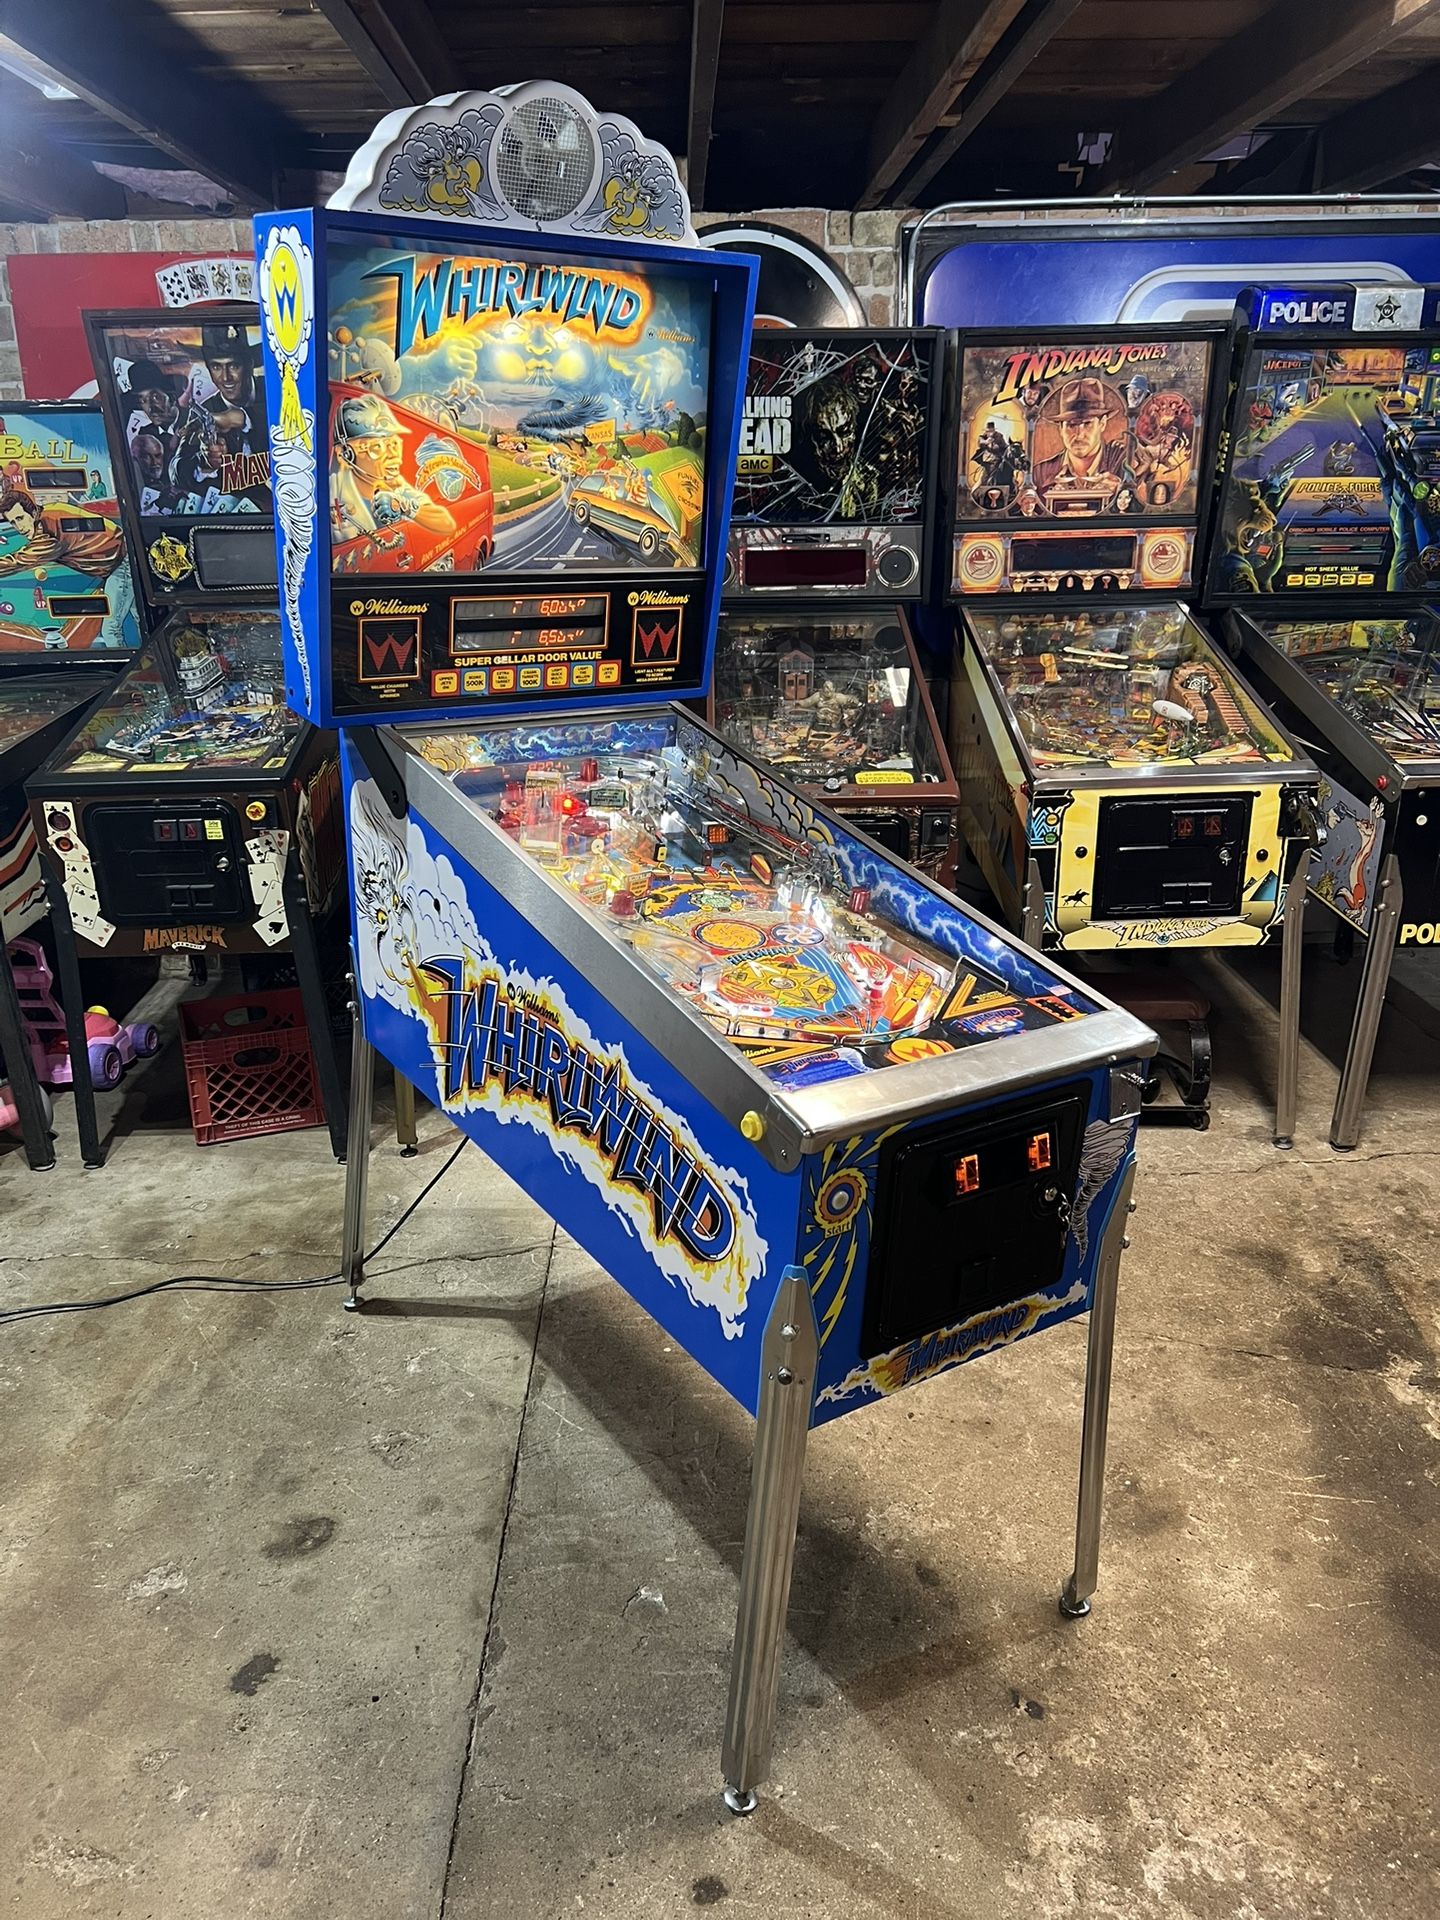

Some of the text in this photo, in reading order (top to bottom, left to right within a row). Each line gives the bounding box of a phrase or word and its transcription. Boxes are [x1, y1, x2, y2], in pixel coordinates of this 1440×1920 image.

[360, 254, 644, 361] WHIRLWIND
[1268, 300, 1347, 323] POLICE
[993, 345, 1168, 406] INDIANA JONES
[0, 434, 88, 463] BALL
[738, 418, 792, 454] EAD
[1297, 482, 1382, 493] POLICE FORCE
[365, 598, 429, 615] Williams
[640, 589, 690, 605] Williams
[454, 656, 492, 667] SUPER
[537, 652, 568, 662] DOOR
[569, 651, 602, 661] VALUE
[143, 924, 228, 952] MAVERICK
[1116, 920, 1181, 947] INDIANA
[516, 985, 560, 1024] Williams
[418, 954, 738, 1261] WHIRLWIND
[826, 1221, 850, 1237] start
[892, 1304, 1030, 1386] WHIRLWIND
